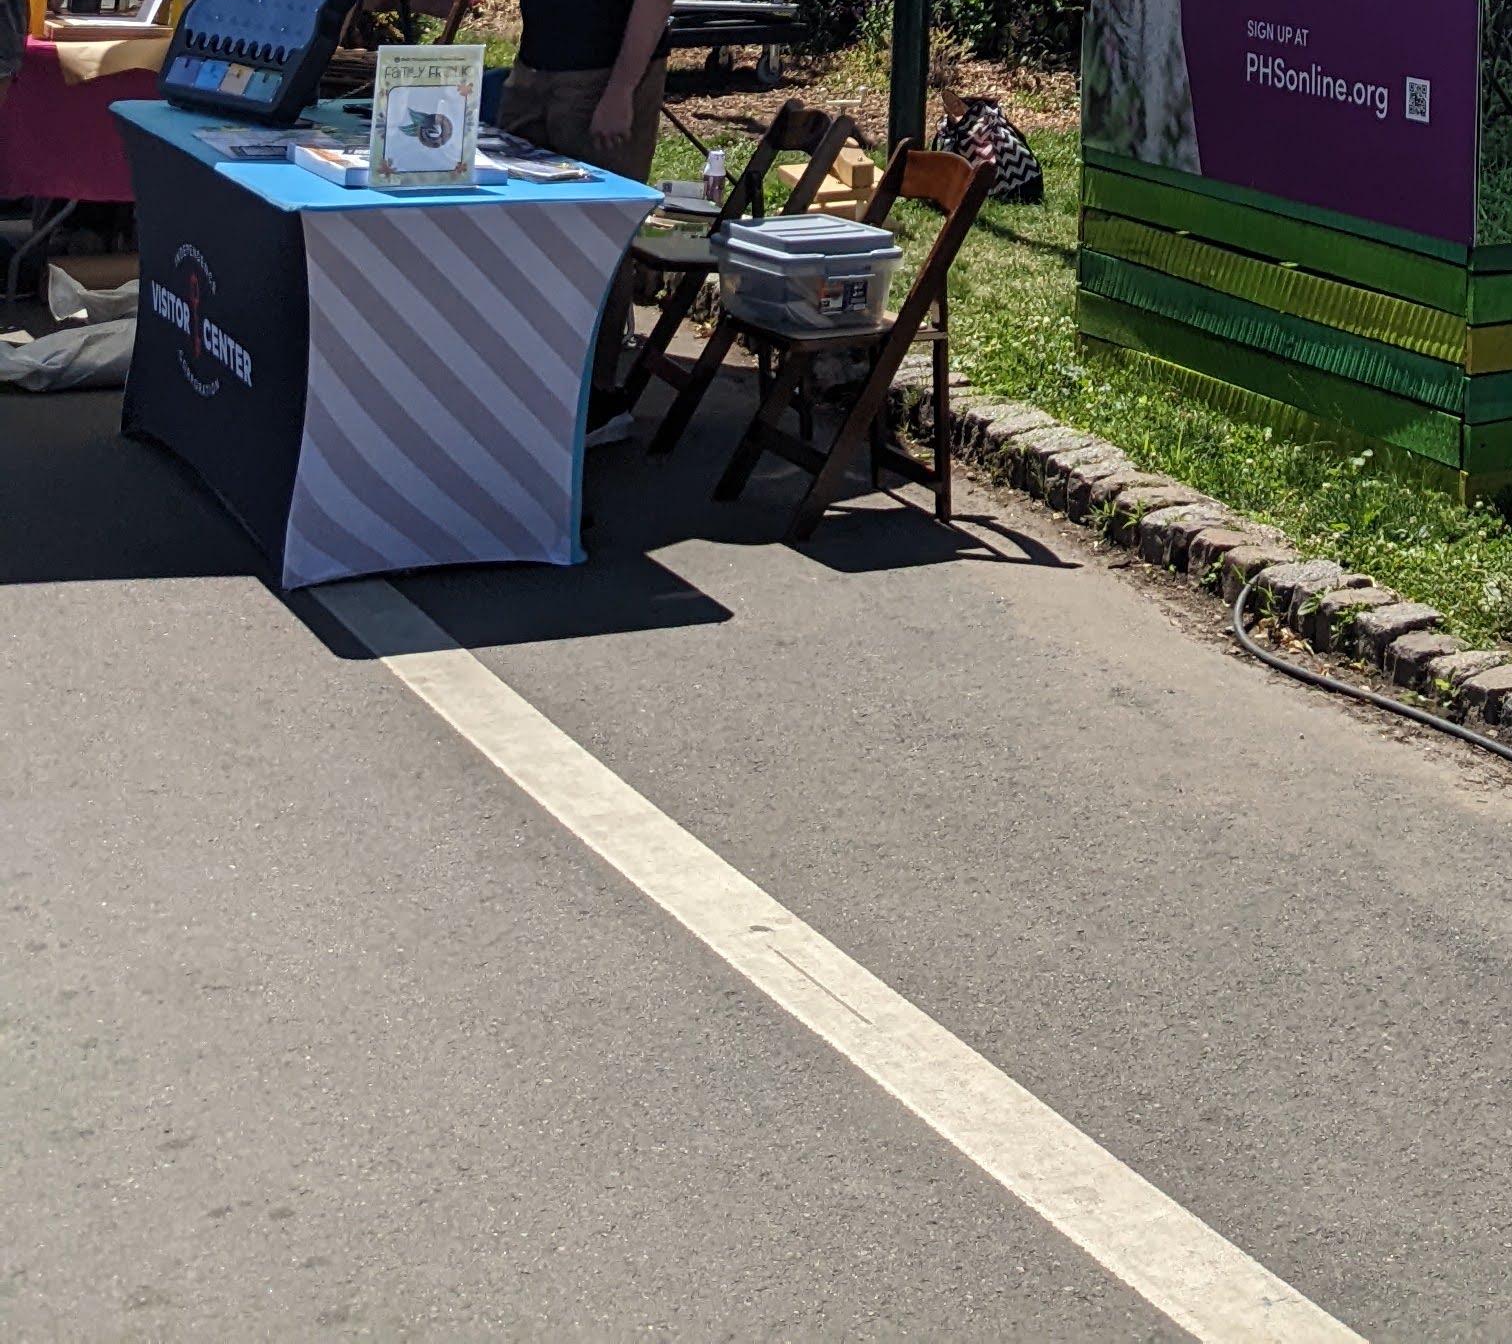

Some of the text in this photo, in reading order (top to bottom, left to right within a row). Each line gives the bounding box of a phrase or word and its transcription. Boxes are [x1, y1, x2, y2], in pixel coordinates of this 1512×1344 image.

[1247, 19, 1309, 47] SIGN UP AT
[1246, 52, 1389, 119] PHSonline.org
[151, 279, 253, 388] VISITOR CENTER
